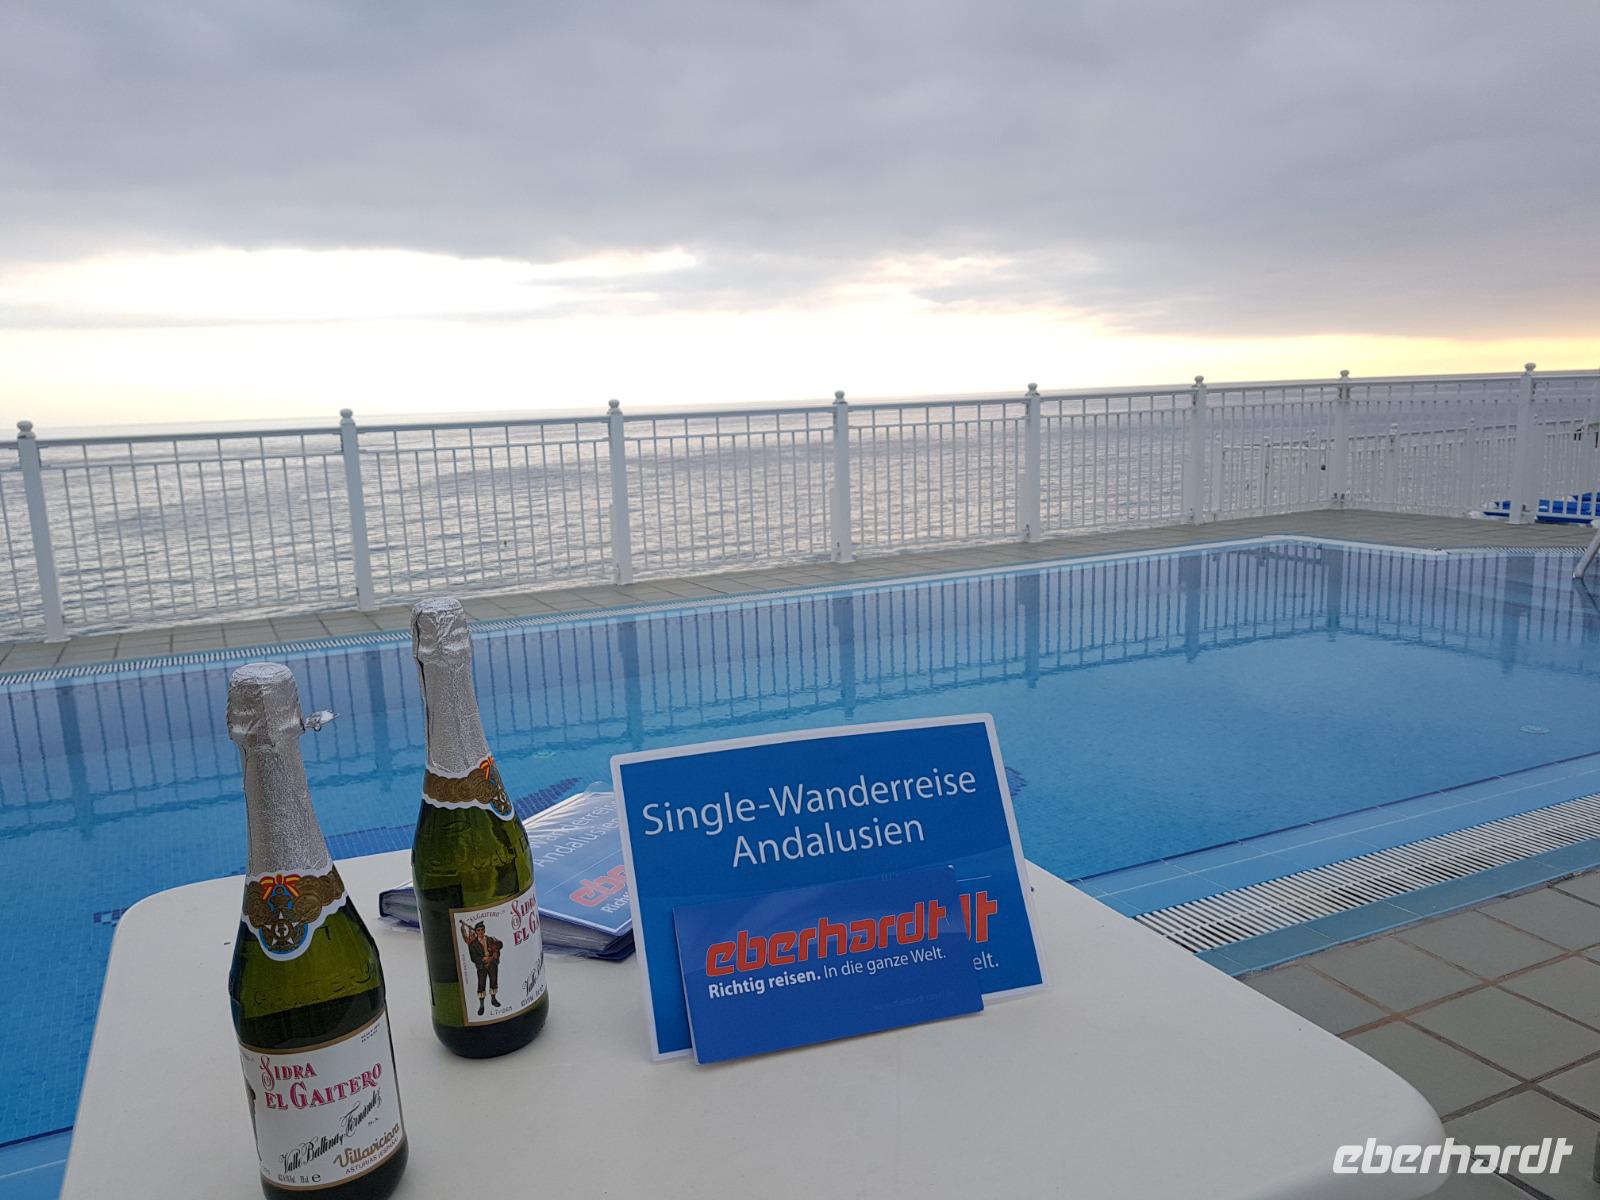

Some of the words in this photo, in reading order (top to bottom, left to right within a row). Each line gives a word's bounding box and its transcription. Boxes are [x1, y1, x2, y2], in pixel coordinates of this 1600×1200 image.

[642, 768, 978, 837] Single-Wanderreise
[732, 817, 925, 868] Andalusien
[706, 900, 947, 977] eberhardt
[973, 951, 999, 970] elt.
[708, 977, 765, 999] Richtig
[768, 970, 822, 988] reisen.
[823, 965, 838, 979] In
[841, 960, 863, 976] die
[866, 954, 909, 975] ganze
[910, 946, 947, 963] Welt.
[260, 1055, 318, 1091] SIDRA
[264, 1091, 288, 1110] EL
[289, 1062, 383, 1110] GAITERO
[333, 1123, 400, 1167] Villaviciosa
